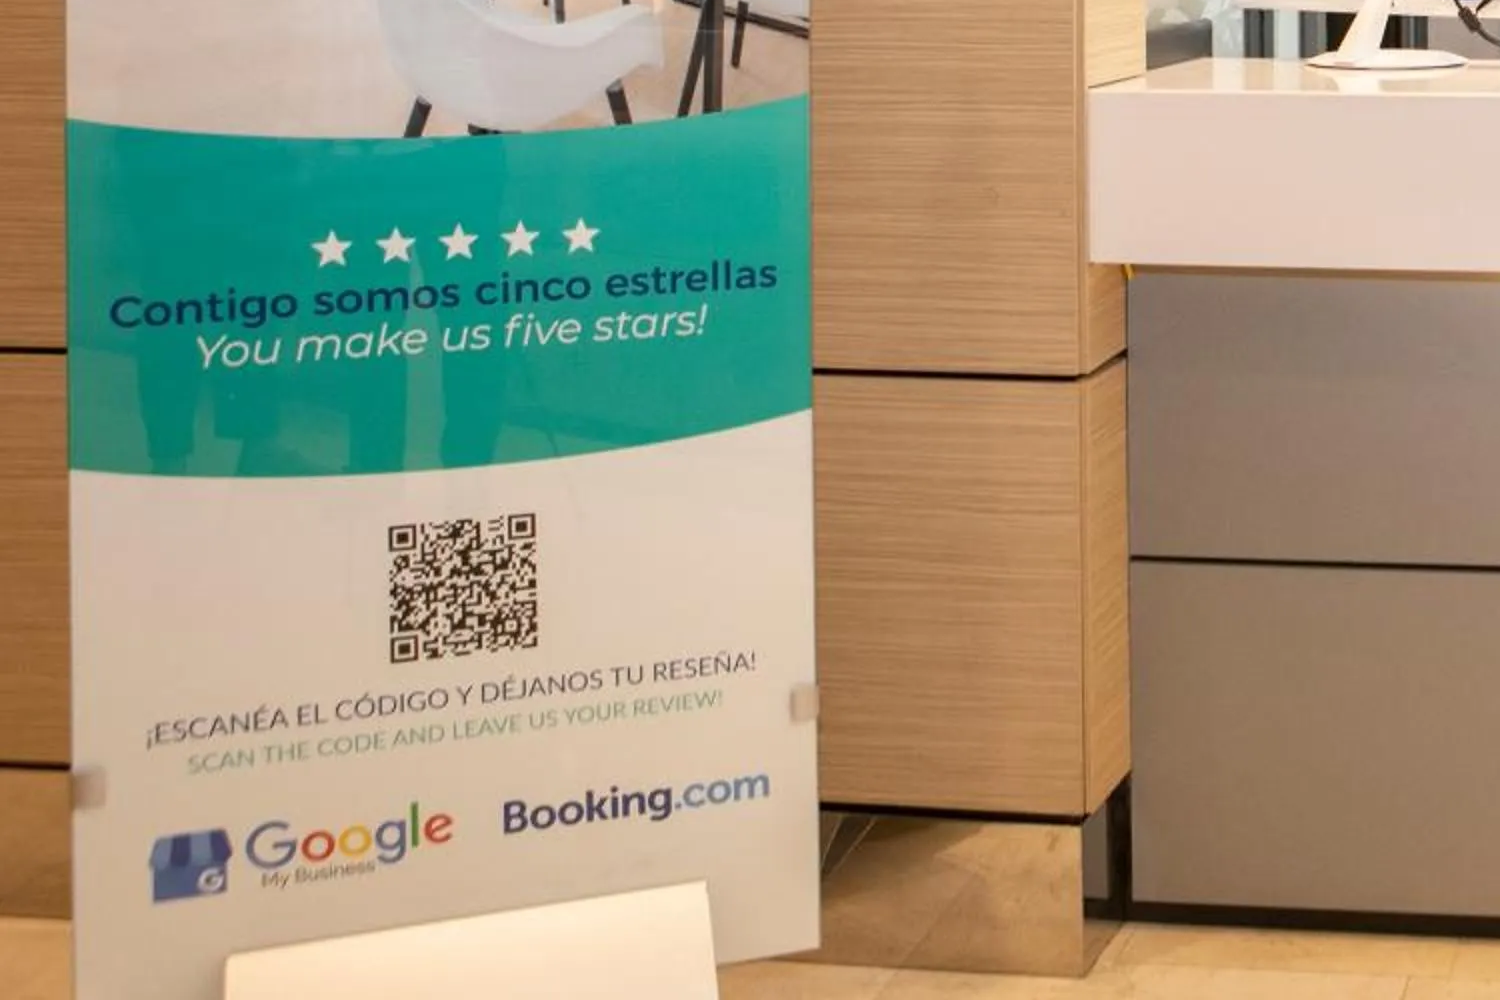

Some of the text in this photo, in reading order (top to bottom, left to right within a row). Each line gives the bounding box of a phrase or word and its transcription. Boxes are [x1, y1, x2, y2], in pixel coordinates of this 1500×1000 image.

[109, 260, 777, 329] Contigo somos cinco estrellas
[196, 303, 708, 369] You make us five stars!
[146, 650, 756, 750] ¡ESCANÉA EL CÓDIGO Y DÉJANOS TU RESEÑA!
[188, 689, 724, 775] SCAN THE CODE AND LEAVE US YOUR REVIEW!
[246, 801, 454, 869] Google
[503, 773, 770, 835] Booking.com
[261, 862, 376, 888] My Business
